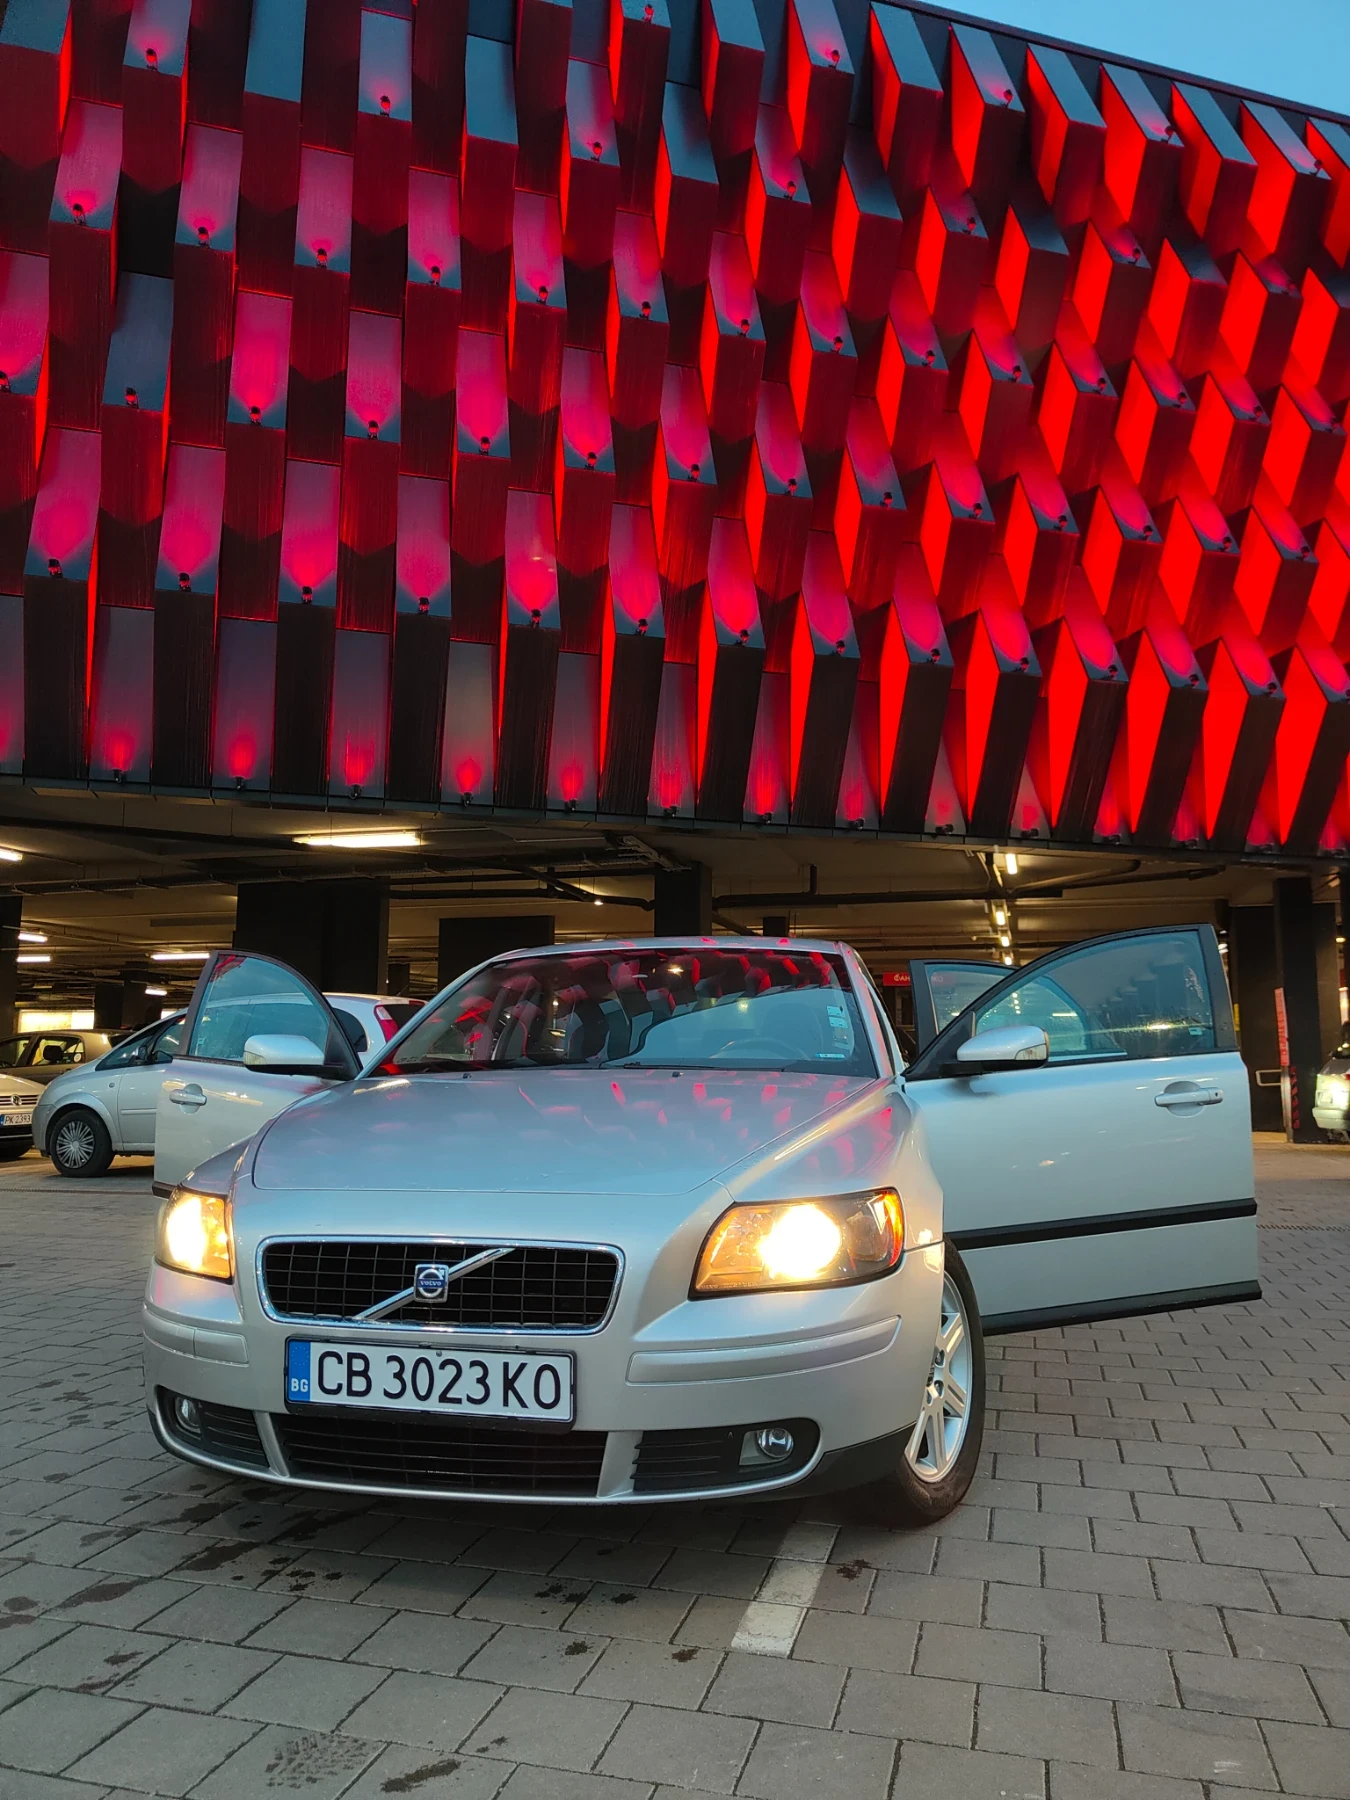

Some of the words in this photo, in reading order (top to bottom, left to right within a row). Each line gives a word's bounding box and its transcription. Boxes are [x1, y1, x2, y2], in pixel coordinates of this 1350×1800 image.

[291, 1378, 309, 1393] BG
[317, 1350, 372, 1398] CB
[383, 1354, 491, 1405] 3023
[502, 1361, 562, 1410] KO
